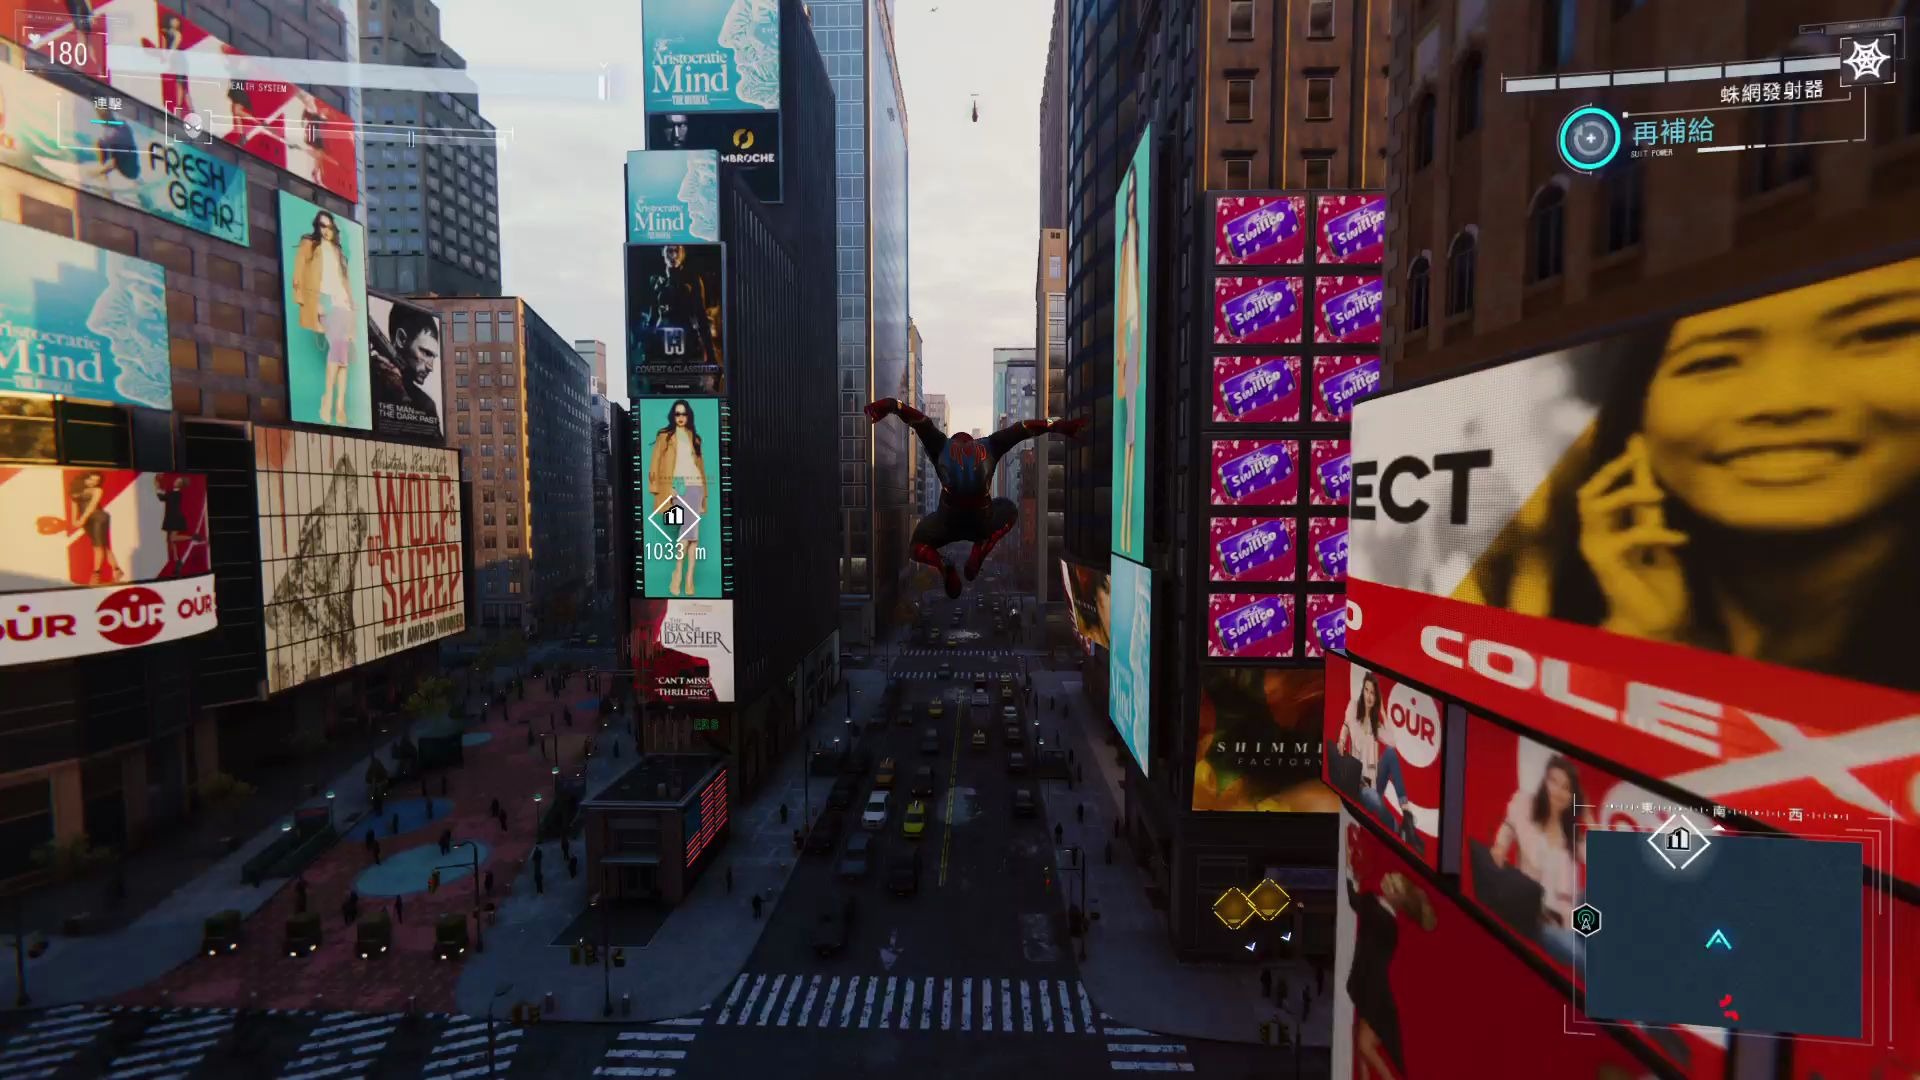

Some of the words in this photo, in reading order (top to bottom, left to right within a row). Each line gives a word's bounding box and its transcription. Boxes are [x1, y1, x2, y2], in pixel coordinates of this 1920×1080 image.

[652, 64, 729, 93] Mind
[149, 142, 226, 194] FRESH
[169, 181, 234, 233] GEAR
[633, 212, 684, 231] Mind
[379, 402, 395, 411] THE
[396, 404, 415, 414] MAN
[379, 409, 395, 419] THE
[396, 411, 419, 421] DARK
[419, 415, 438, 424] PAST
[1350, 449, 1492, 524] ECT
[381, 543, 460, 627] SHEEP
[0, 604, 77, 641] UR
[407, 621, 435, 643] AWARD
[436, 613, 464, 633] WINNER
[664, 618, 694, 632] REIGN
[664, 631, 732, 654] DASHER
[1391, 697, 1434, 746] OUR
